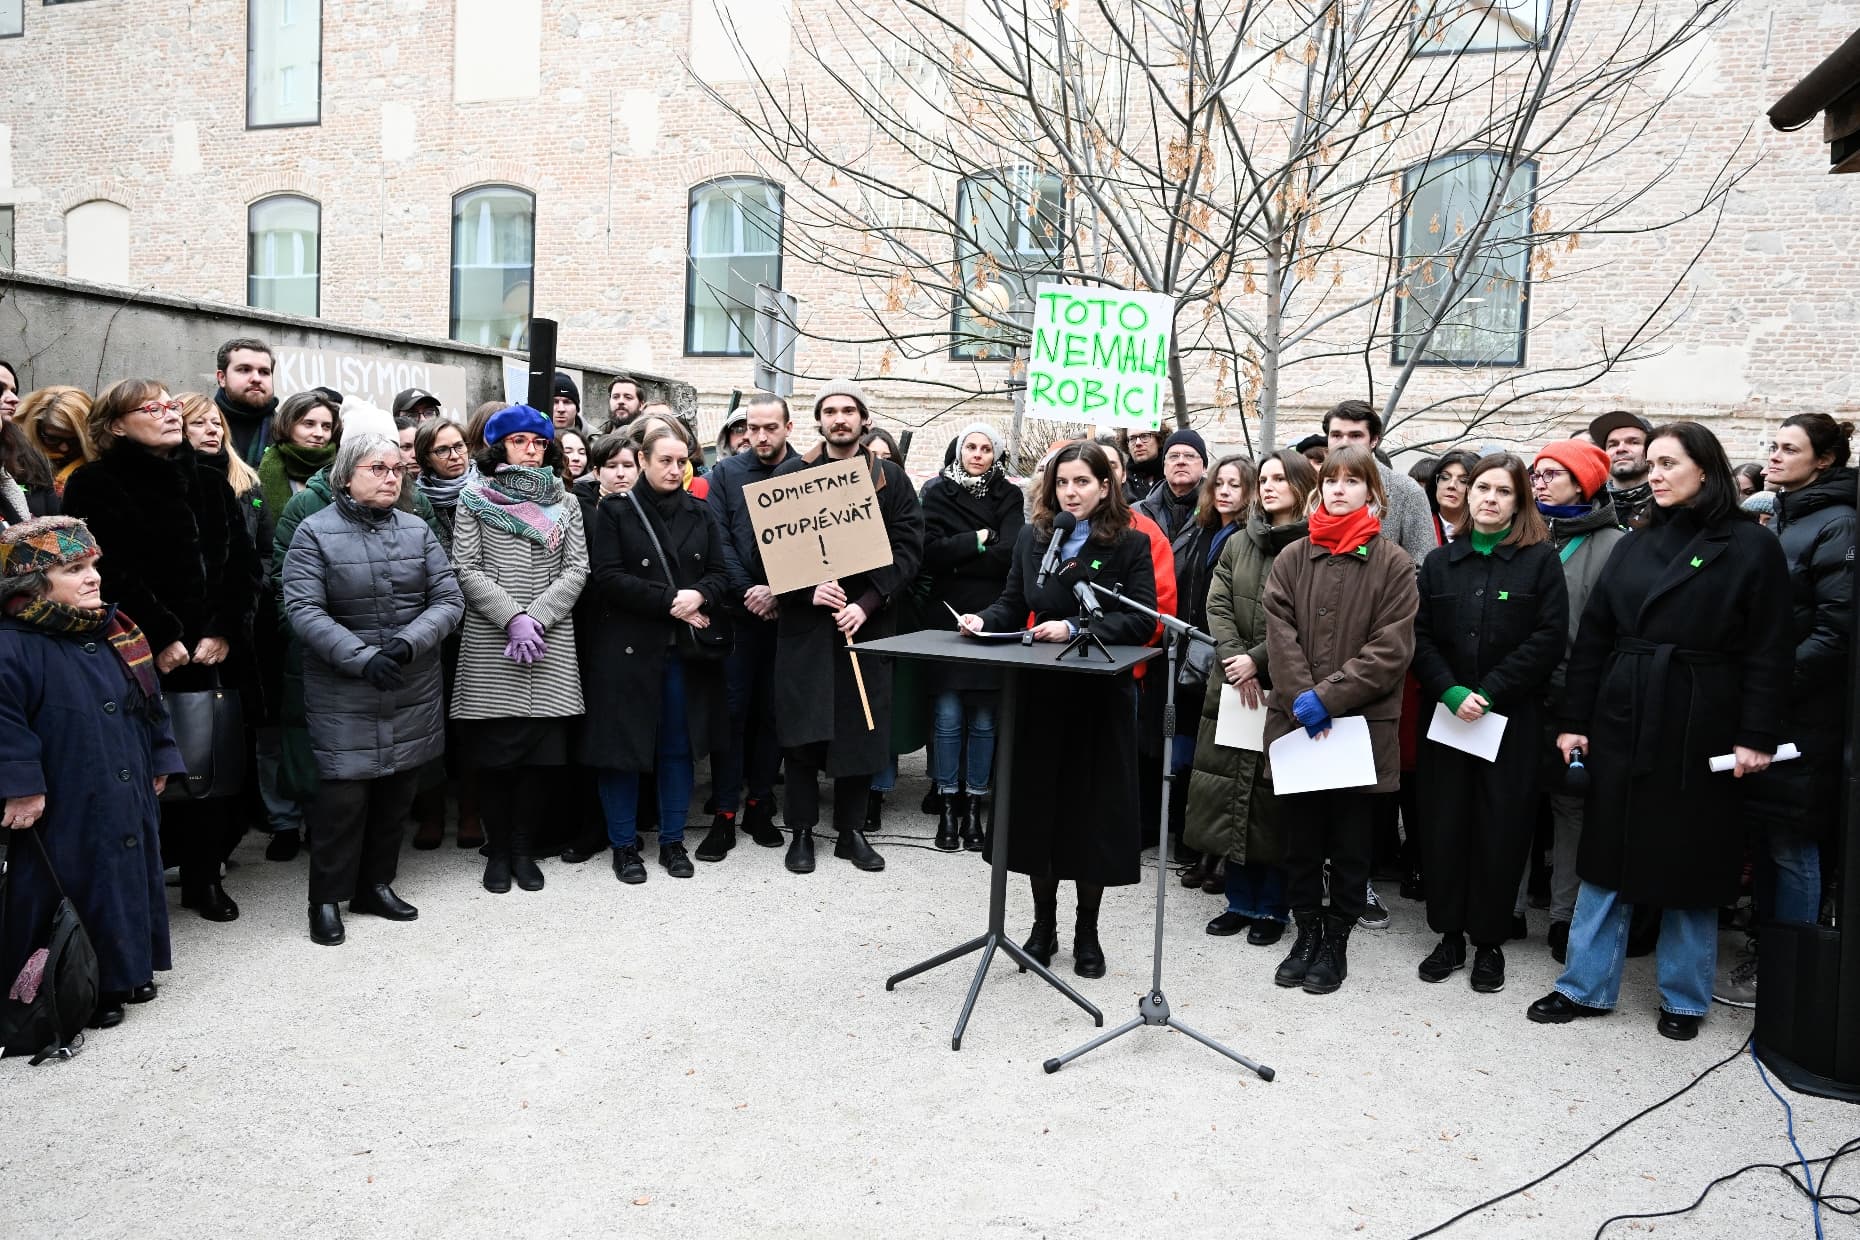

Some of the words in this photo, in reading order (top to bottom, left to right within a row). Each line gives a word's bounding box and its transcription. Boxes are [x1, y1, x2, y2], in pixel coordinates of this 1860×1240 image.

[1039, 292, 1149, 331] TOTO
[1035, 327, 1168, 377] NEMALA
[1030, 370, 1159, 429] ROBIC!
[757, 470, 861, 508] ODMIETAME
[818, 534, 830, 565] !
